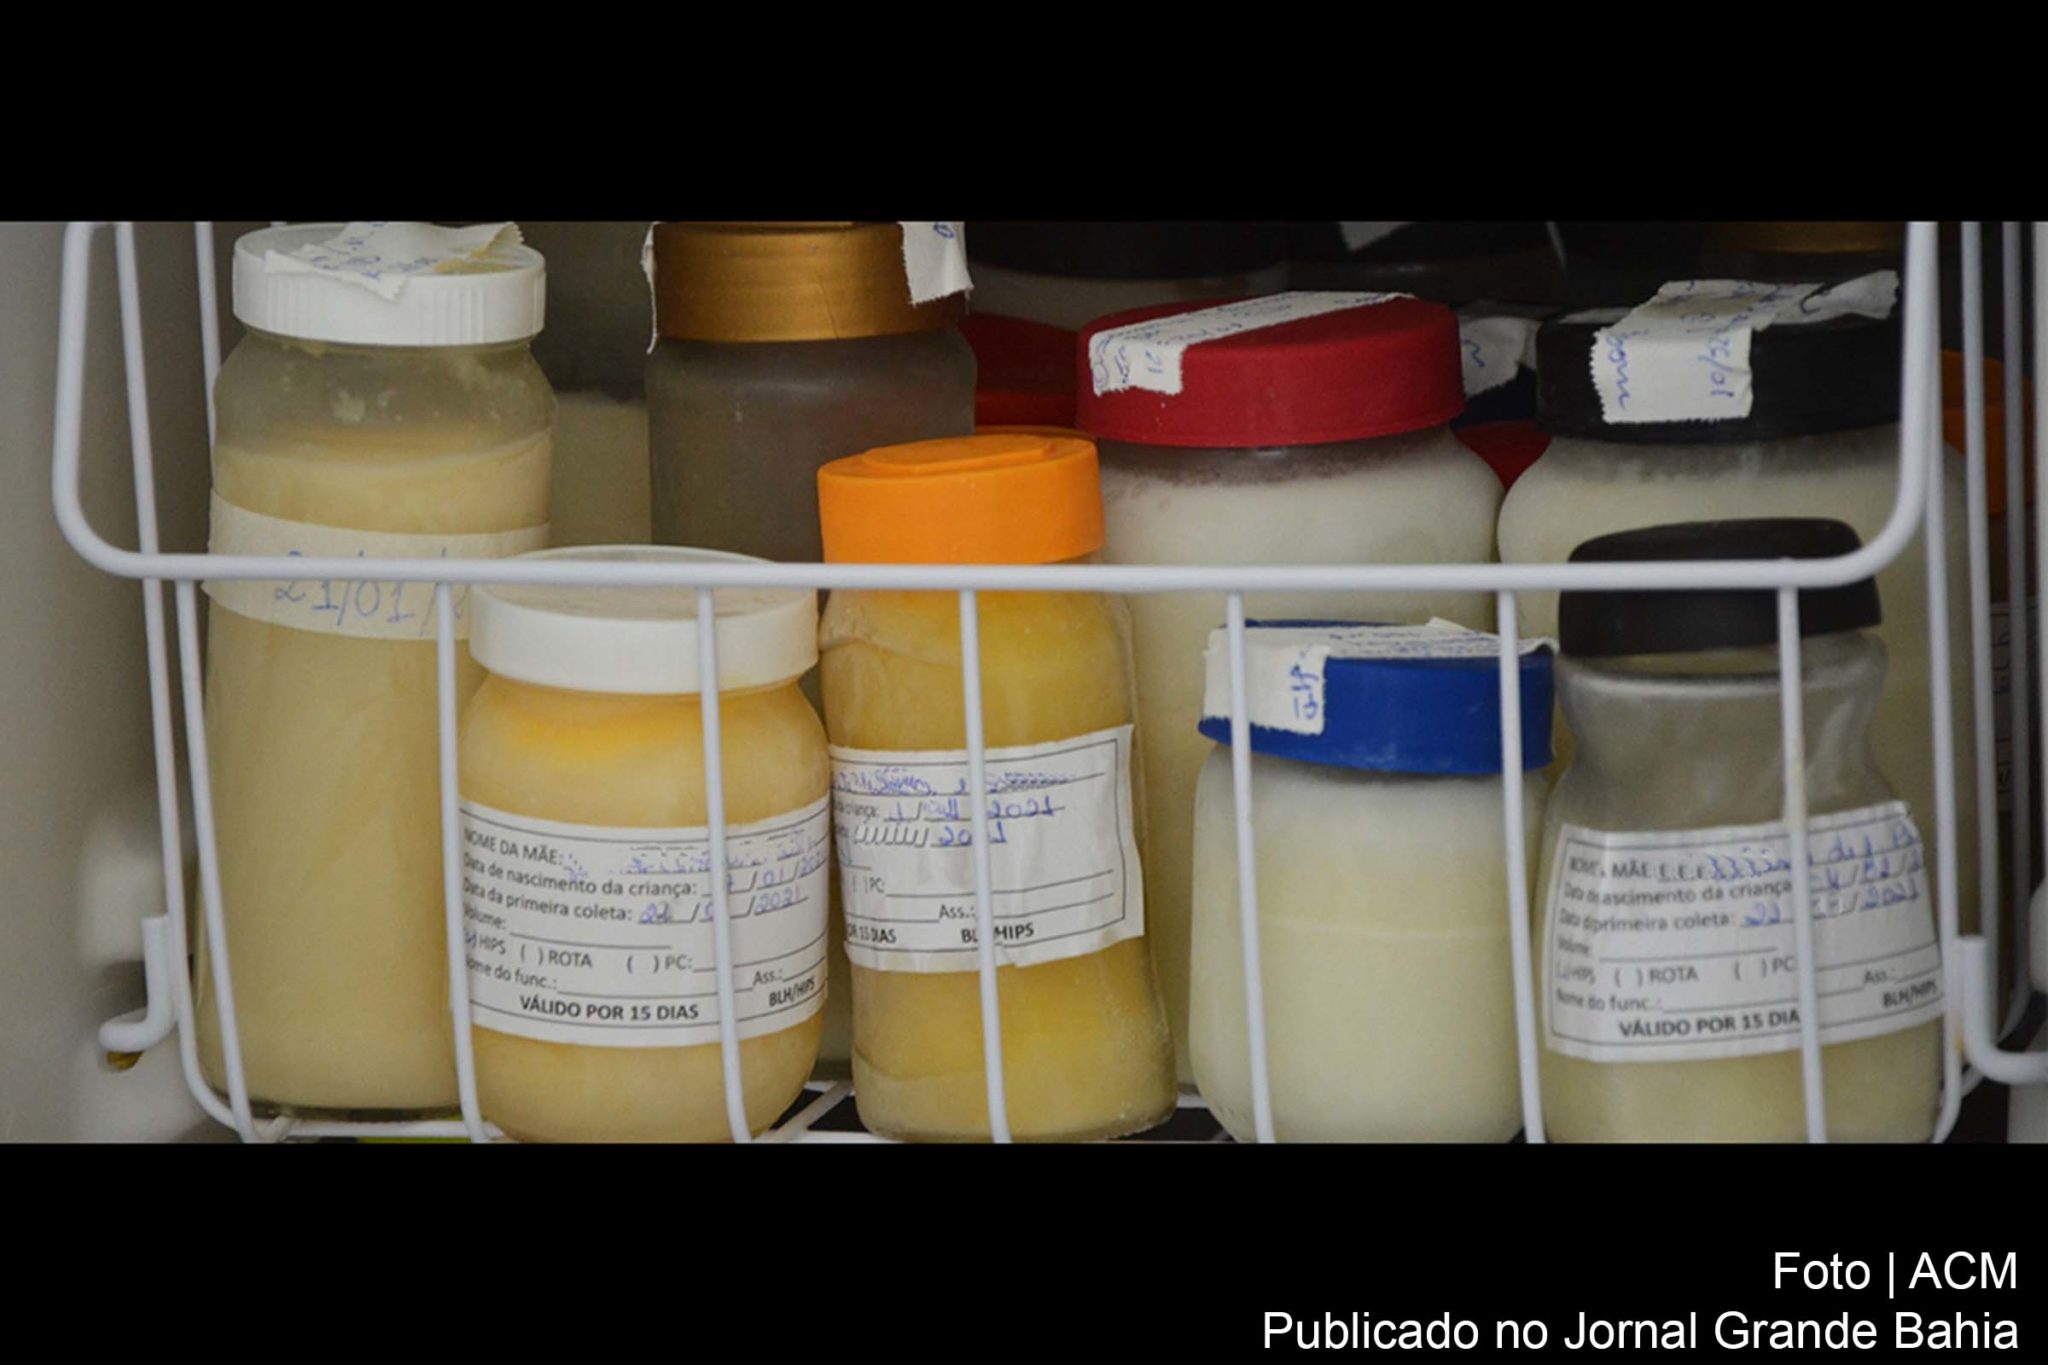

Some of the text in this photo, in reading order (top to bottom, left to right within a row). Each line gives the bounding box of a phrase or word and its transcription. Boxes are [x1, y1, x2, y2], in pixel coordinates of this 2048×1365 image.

[501, 840, 519, 858] DA
[488, 863, 504, 881] de
[507, 870, 597, 894] nascimento
[602, 880, 623, 896] da
[628, 881, 697, 898] criança:
[1702, 886, 1724, 900] da
[487, 888, 503, 904] da
[506, 894, 569, 916] primeira
[574, 904, 633, 921] coleta:
[549, 950, 593, 968] ROTA
[495, 965, 511, 981] do
[1650, 967, 1698, 984] ROTA
[520, 994, 581, 1018] VÁLIDO
[586, 1004, 624, 1020] POR
[630, 1005, 651, 1021] 15
[657, 1004, 699, 1020] DIAS
[1618, 1019, 1691, 1037] VÁLIDO
[1697, 1016, 1736, 1034] POR
[1743, 1012, 1763, 1030] 15
